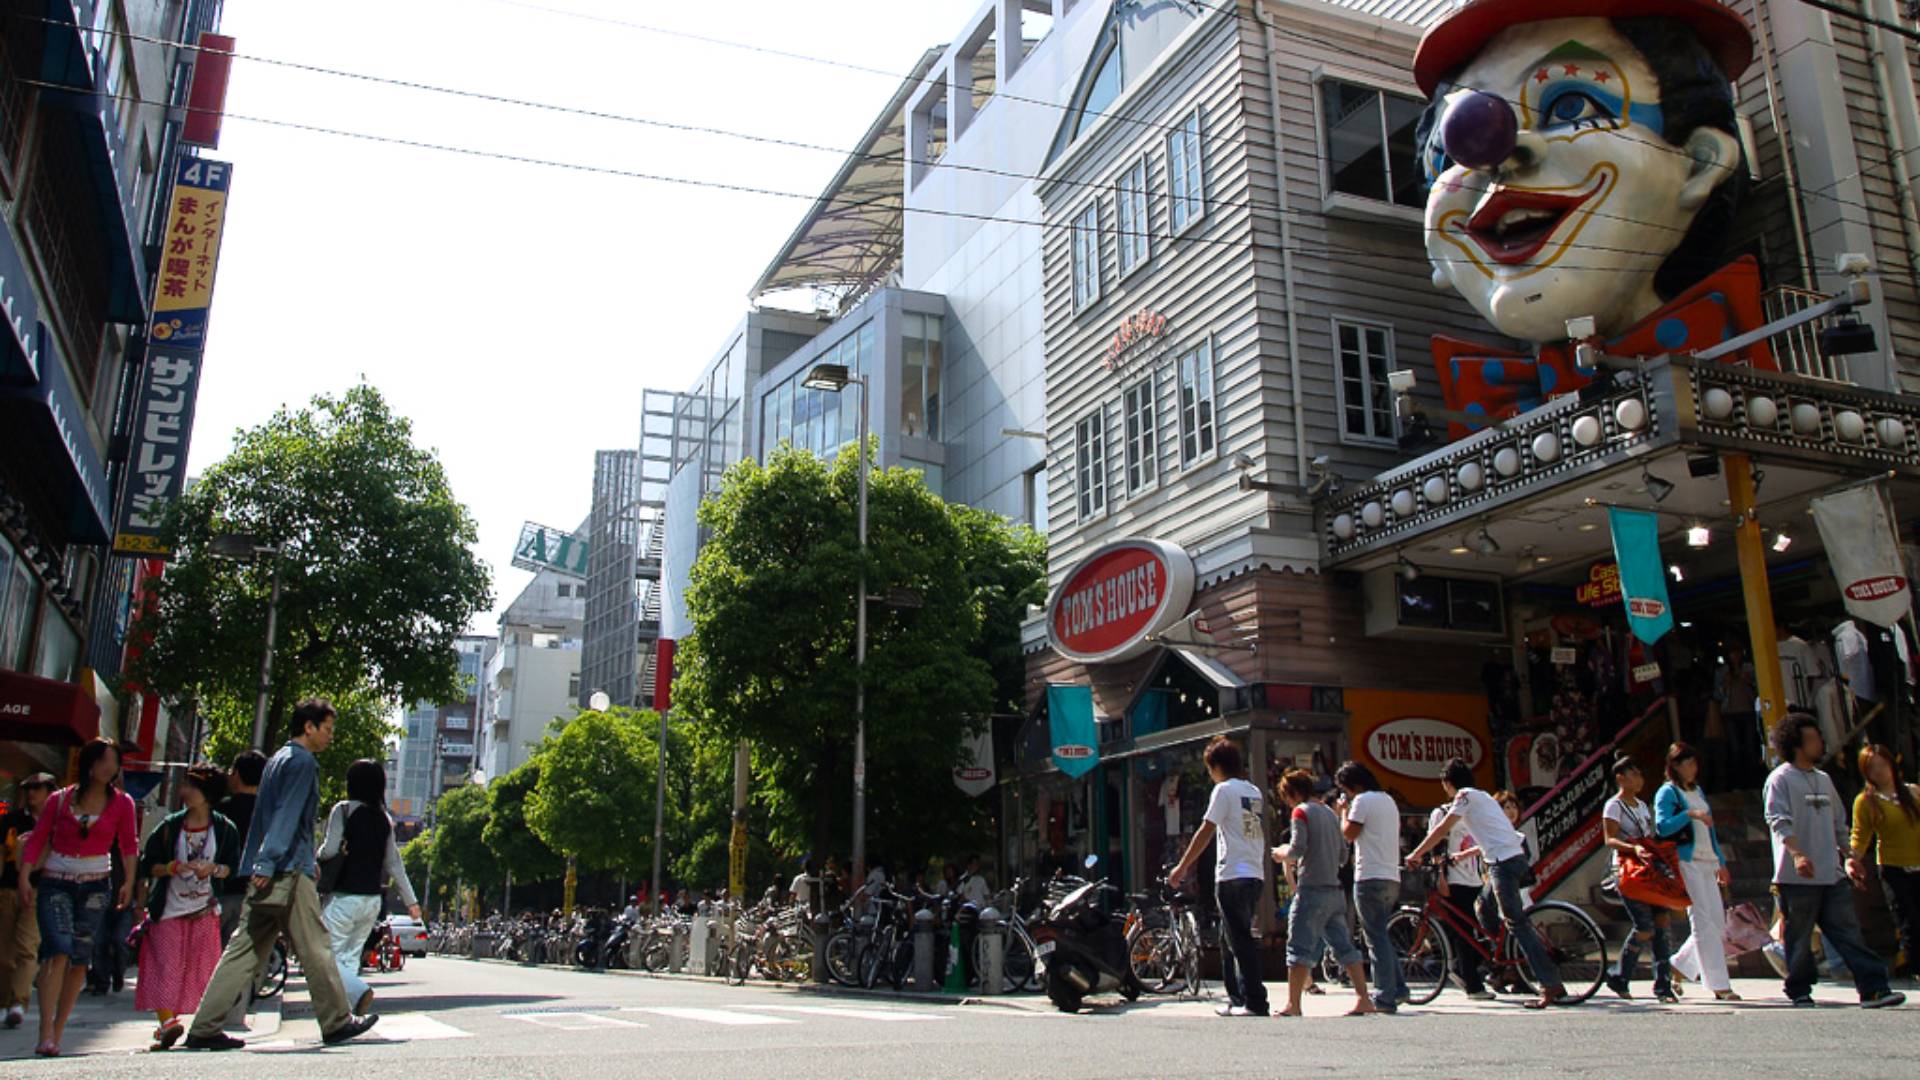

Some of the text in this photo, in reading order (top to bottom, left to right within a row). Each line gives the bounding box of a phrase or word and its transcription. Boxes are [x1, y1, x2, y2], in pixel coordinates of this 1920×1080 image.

[184, 163, 224, 187] 4F
[163, 197, 199, 298] まんが喫茶
[194, 201, 220, 292] インターネット
[128, 356, 194, 528] サンビレッジ
[1062, 560, 1157, 639] TOM'S HOUSE
[1576, 584, 1601, 605] Life
[1589, 563, 1619, 583] Cas
[1377, 731, 1474, 764] TOM'S HOUSE
